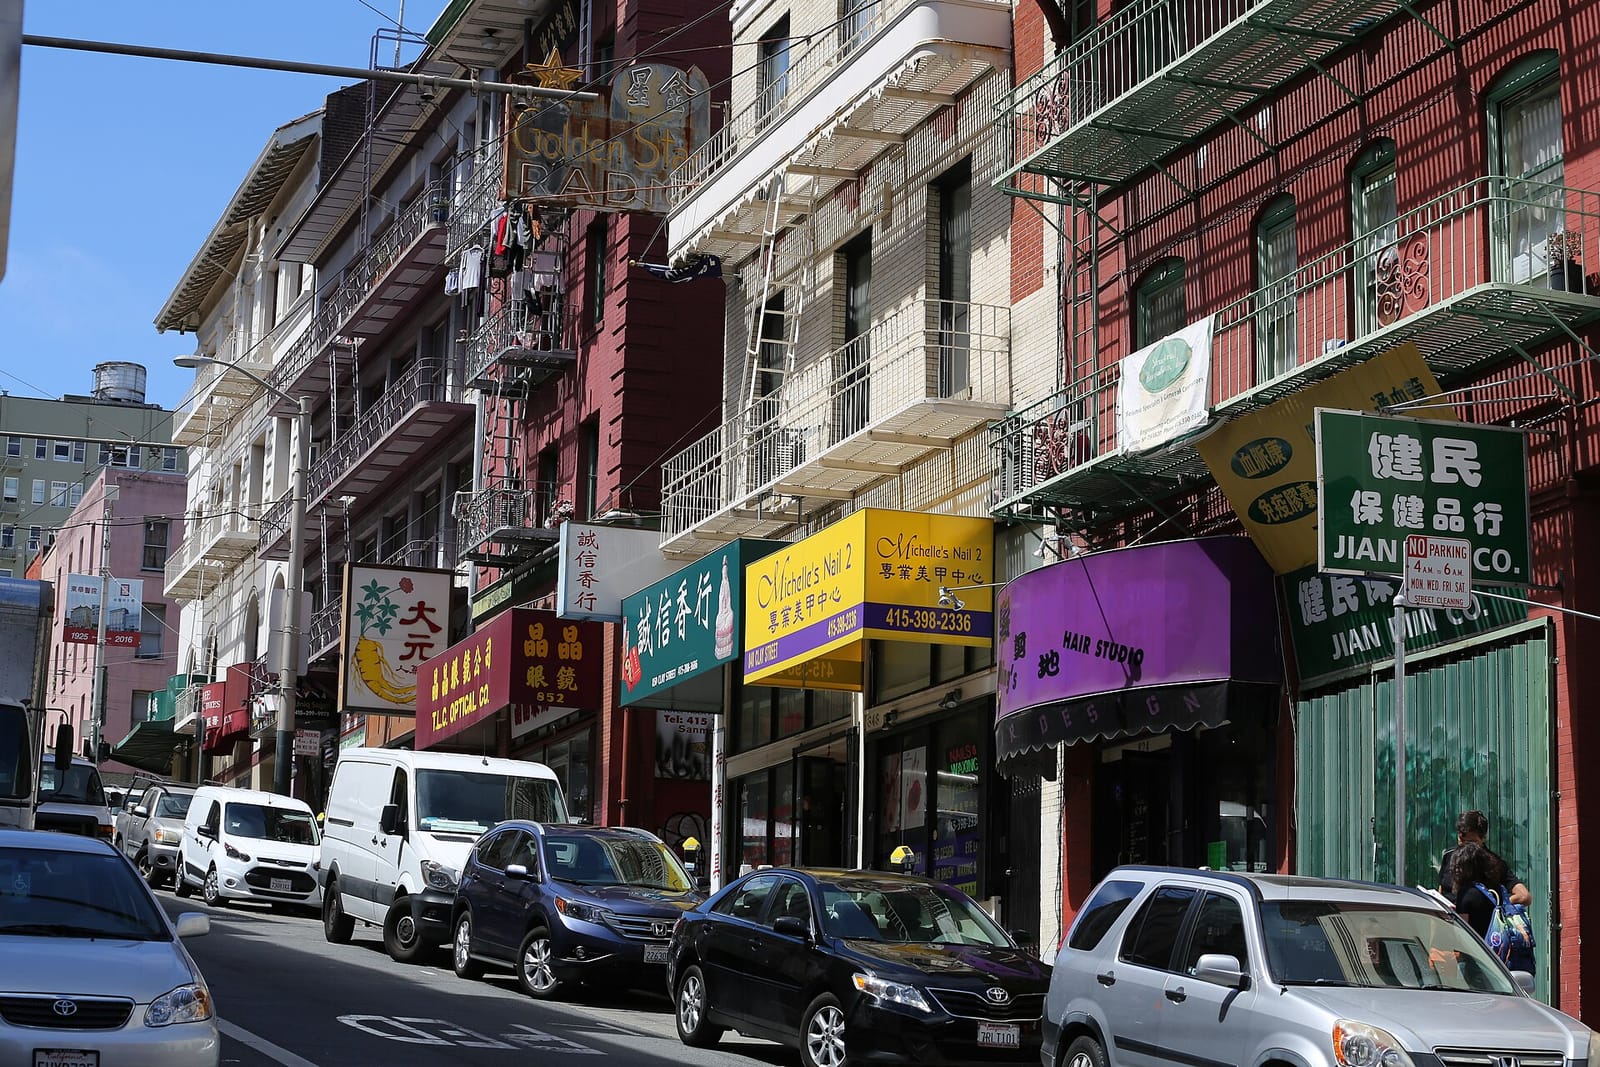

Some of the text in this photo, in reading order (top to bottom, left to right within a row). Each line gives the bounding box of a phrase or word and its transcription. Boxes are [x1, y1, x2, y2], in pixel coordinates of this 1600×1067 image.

[512, 106, 623, 163] Golden
[1368, 431, 1482, 488] 健民
[1350, 489, 1504, 537] 保健品行
[876, 532, 983, 562] Michelle's Nail 2
[1333, 535, 1520, 575] JIAN CO.
[1409, 537, 1467, 559] NO PARKING
[574, 529, 600, 612] 誠信香行
[757, 543, 852, 609] Michelle's Nail 2
[878, 563, 984, 585] 專業美甲中心
[1413, 559, 1421, 573] 4
[1443, 562, 1451, 576] 6
[637, 570, 713, 658] 誠信香行
[767, 586, 842, 634] 專業美甲中心
[1414, 595, 1463, 606] STREET CLEANING
[399, 600, 443, 661] 大元
[885, 608, 971, 632] 415-398-2336
[71, 632, 133, 643] 1925 2016
[524, 622, 583, 661] 晶晶
[764, 642, 778, 663] STREET
[1063, 630, 1144, 667] HAIR STUDIO
[1332, 622, 1382, 660] JIAN
[431, 636, 492, 702] 晶晶眼鏡公司
[526, 664, 578, 692] 眼鏡
[449, 691, 477, 724] OPTICAL
[479, 683, 490, 708] CO.
[536, 691, 565, 703] 852
[664, 714, 708, 726] Tel: 415
[949, 745, 972, 762] NAILS
[950, 757, 979, 776] WAXING
[980, 1031, 1015, 1044] 7RLT101
